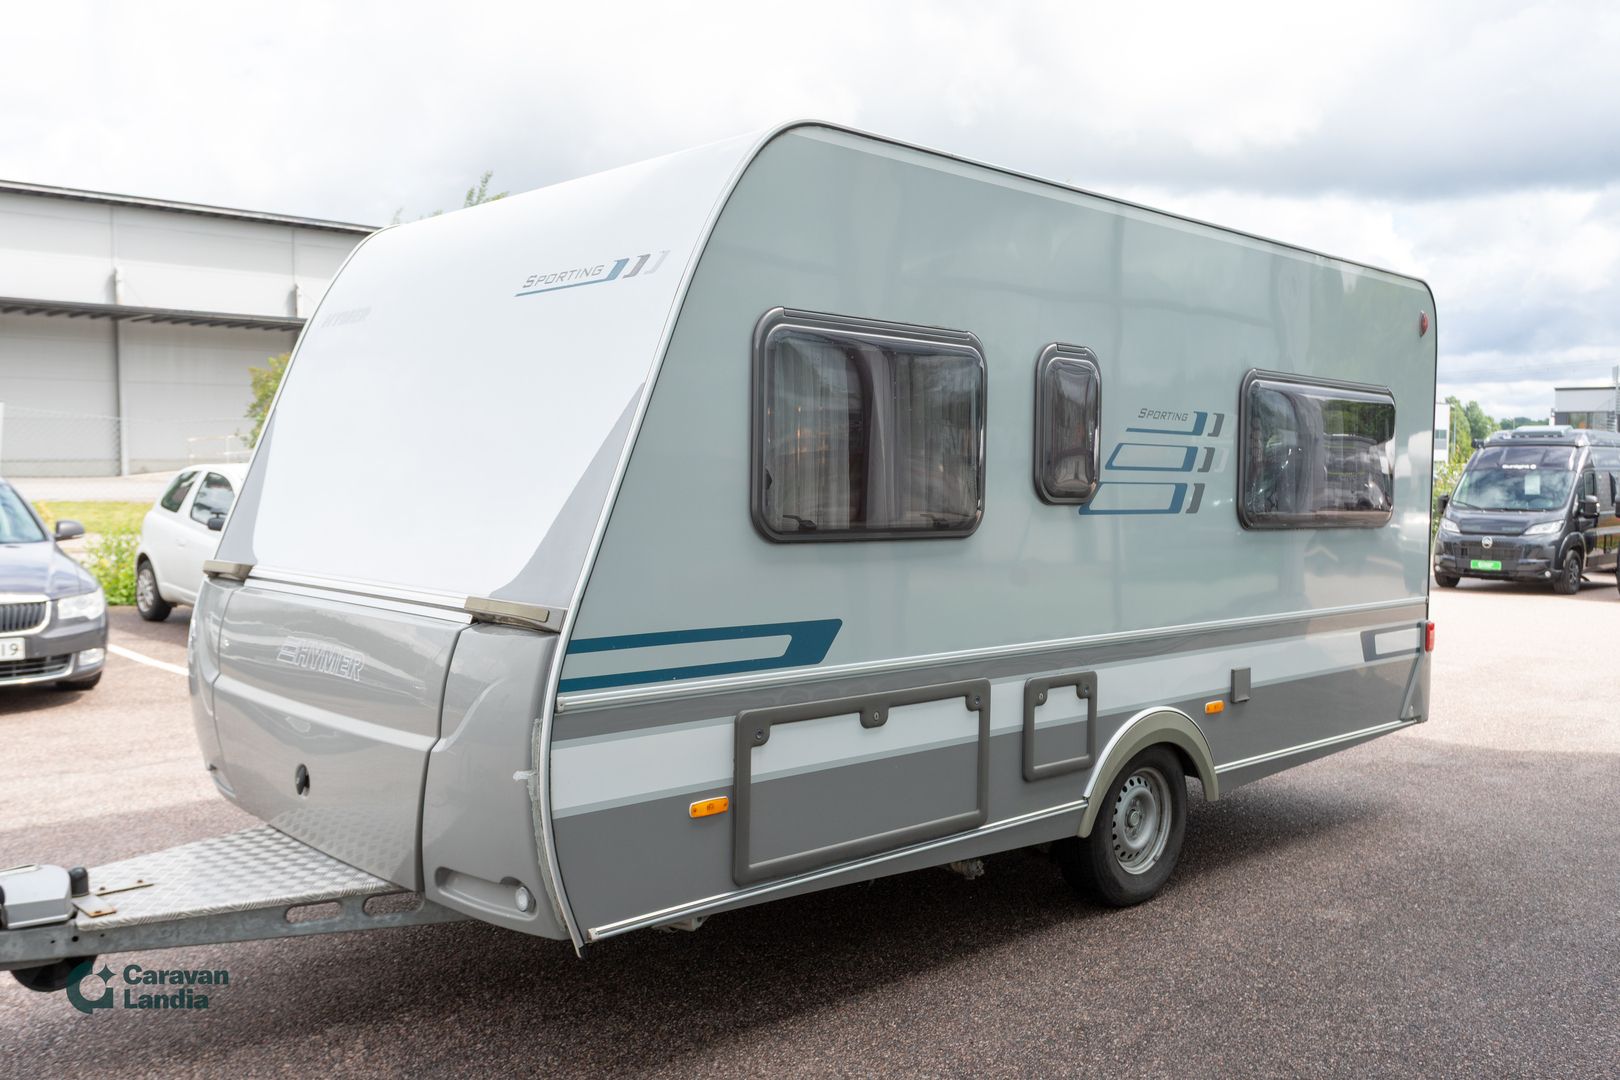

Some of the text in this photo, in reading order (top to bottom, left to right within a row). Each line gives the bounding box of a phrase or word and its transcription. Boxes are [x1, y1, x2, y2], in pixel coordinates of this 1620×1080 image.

[522, 264, 605, 288] SPORTING
[1138, 408, 1189, 422] SPORTING
[294, 641, 365, 682] HYMER
